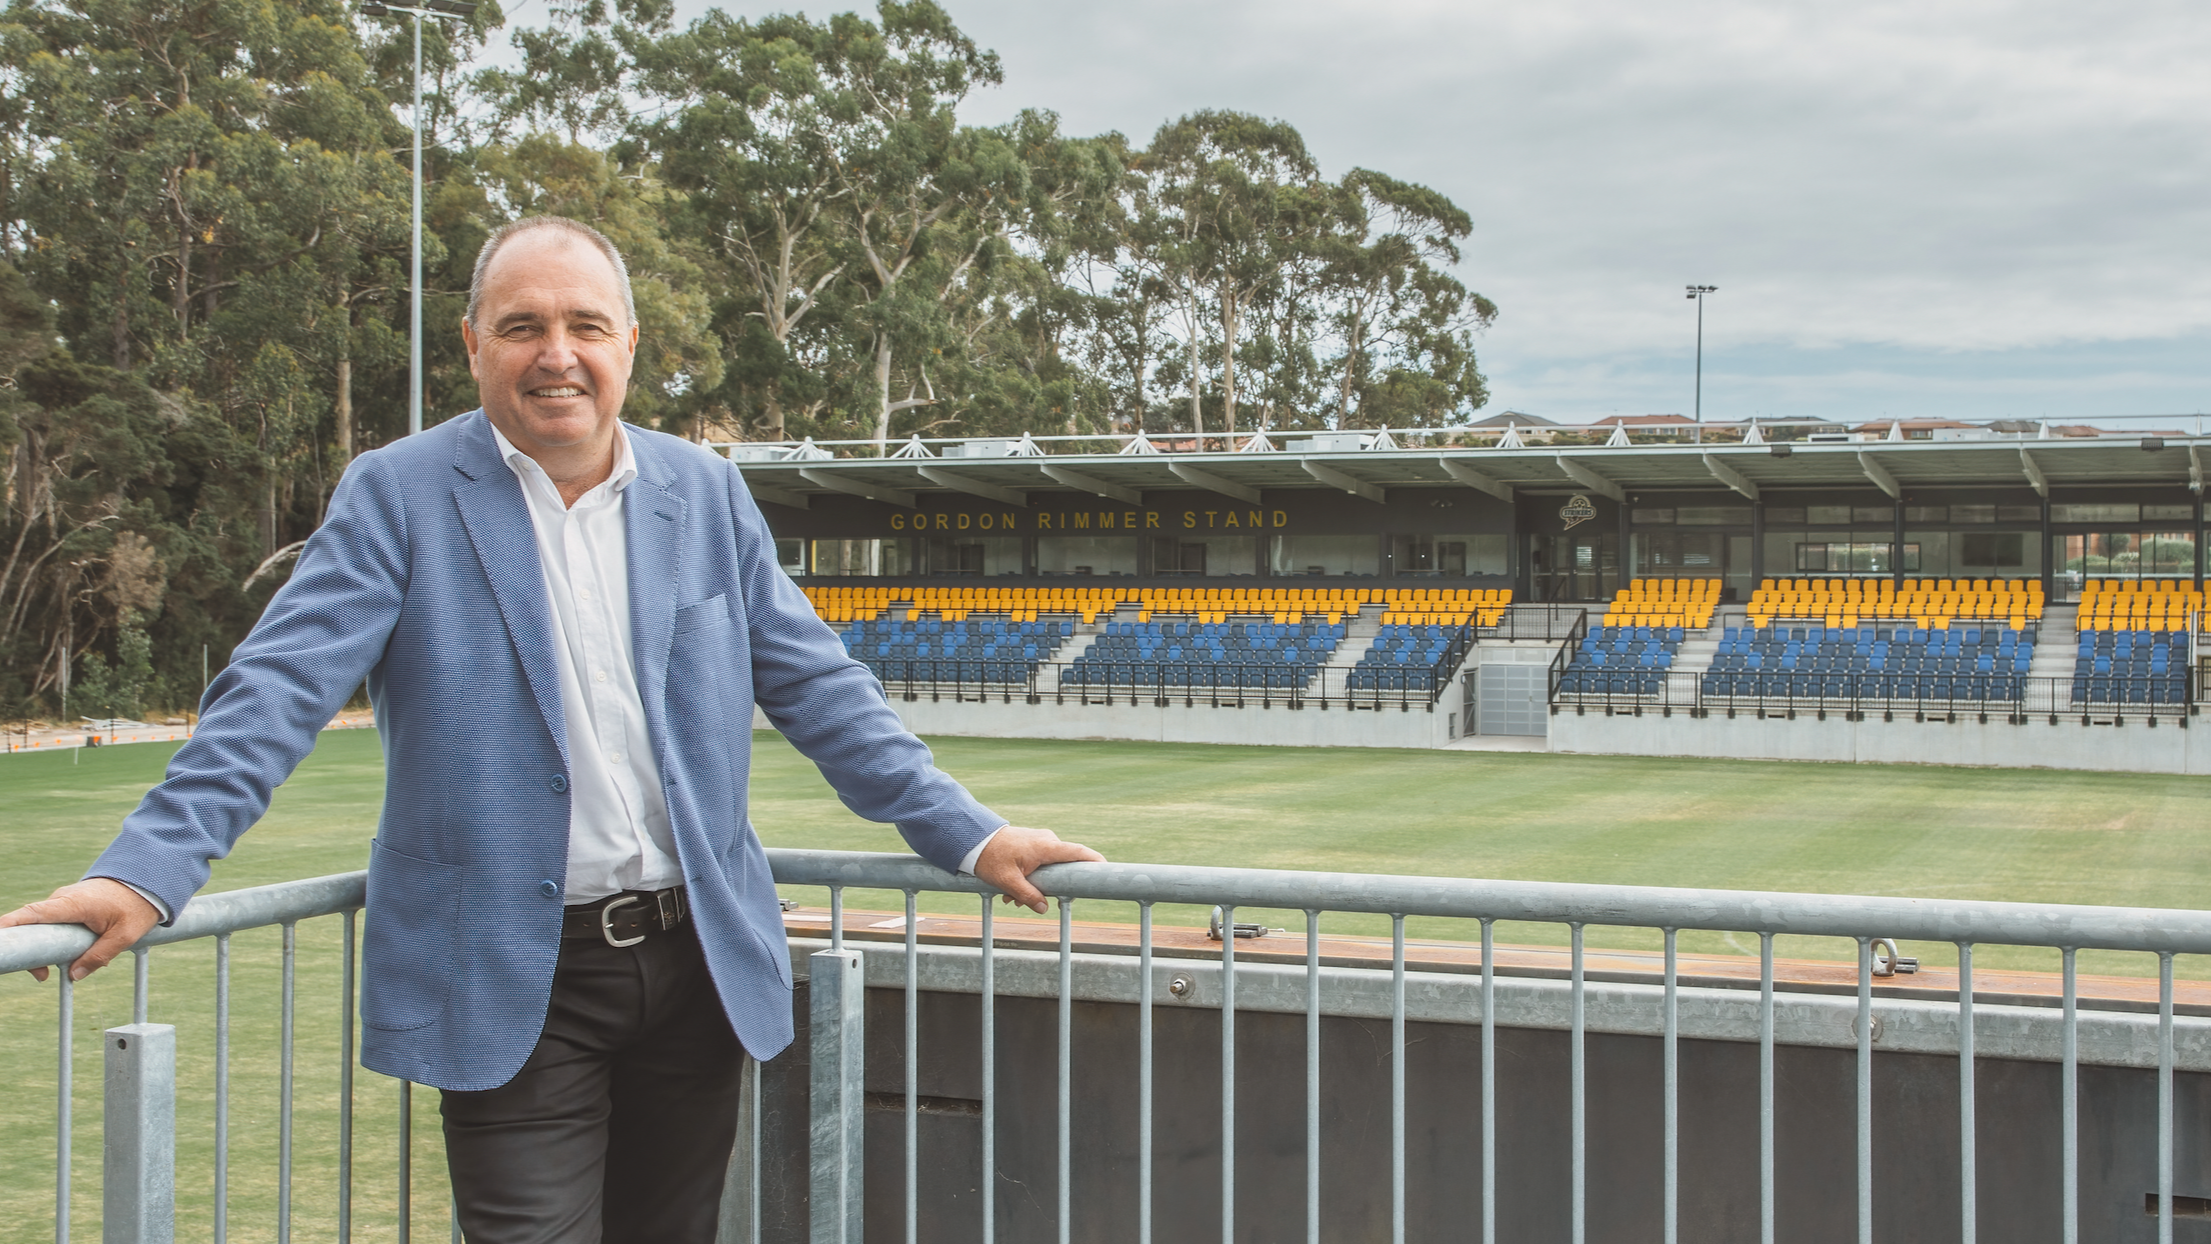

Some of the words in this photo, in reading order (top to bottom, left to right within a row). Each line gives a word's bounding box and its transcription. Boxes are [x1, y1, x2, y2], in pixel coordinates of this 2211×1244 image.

[890, 512, 1016, 531] GORDON
[1037, 511, 1161, 530] RIMMER
[1182, 509, 1288, 529] STAND
